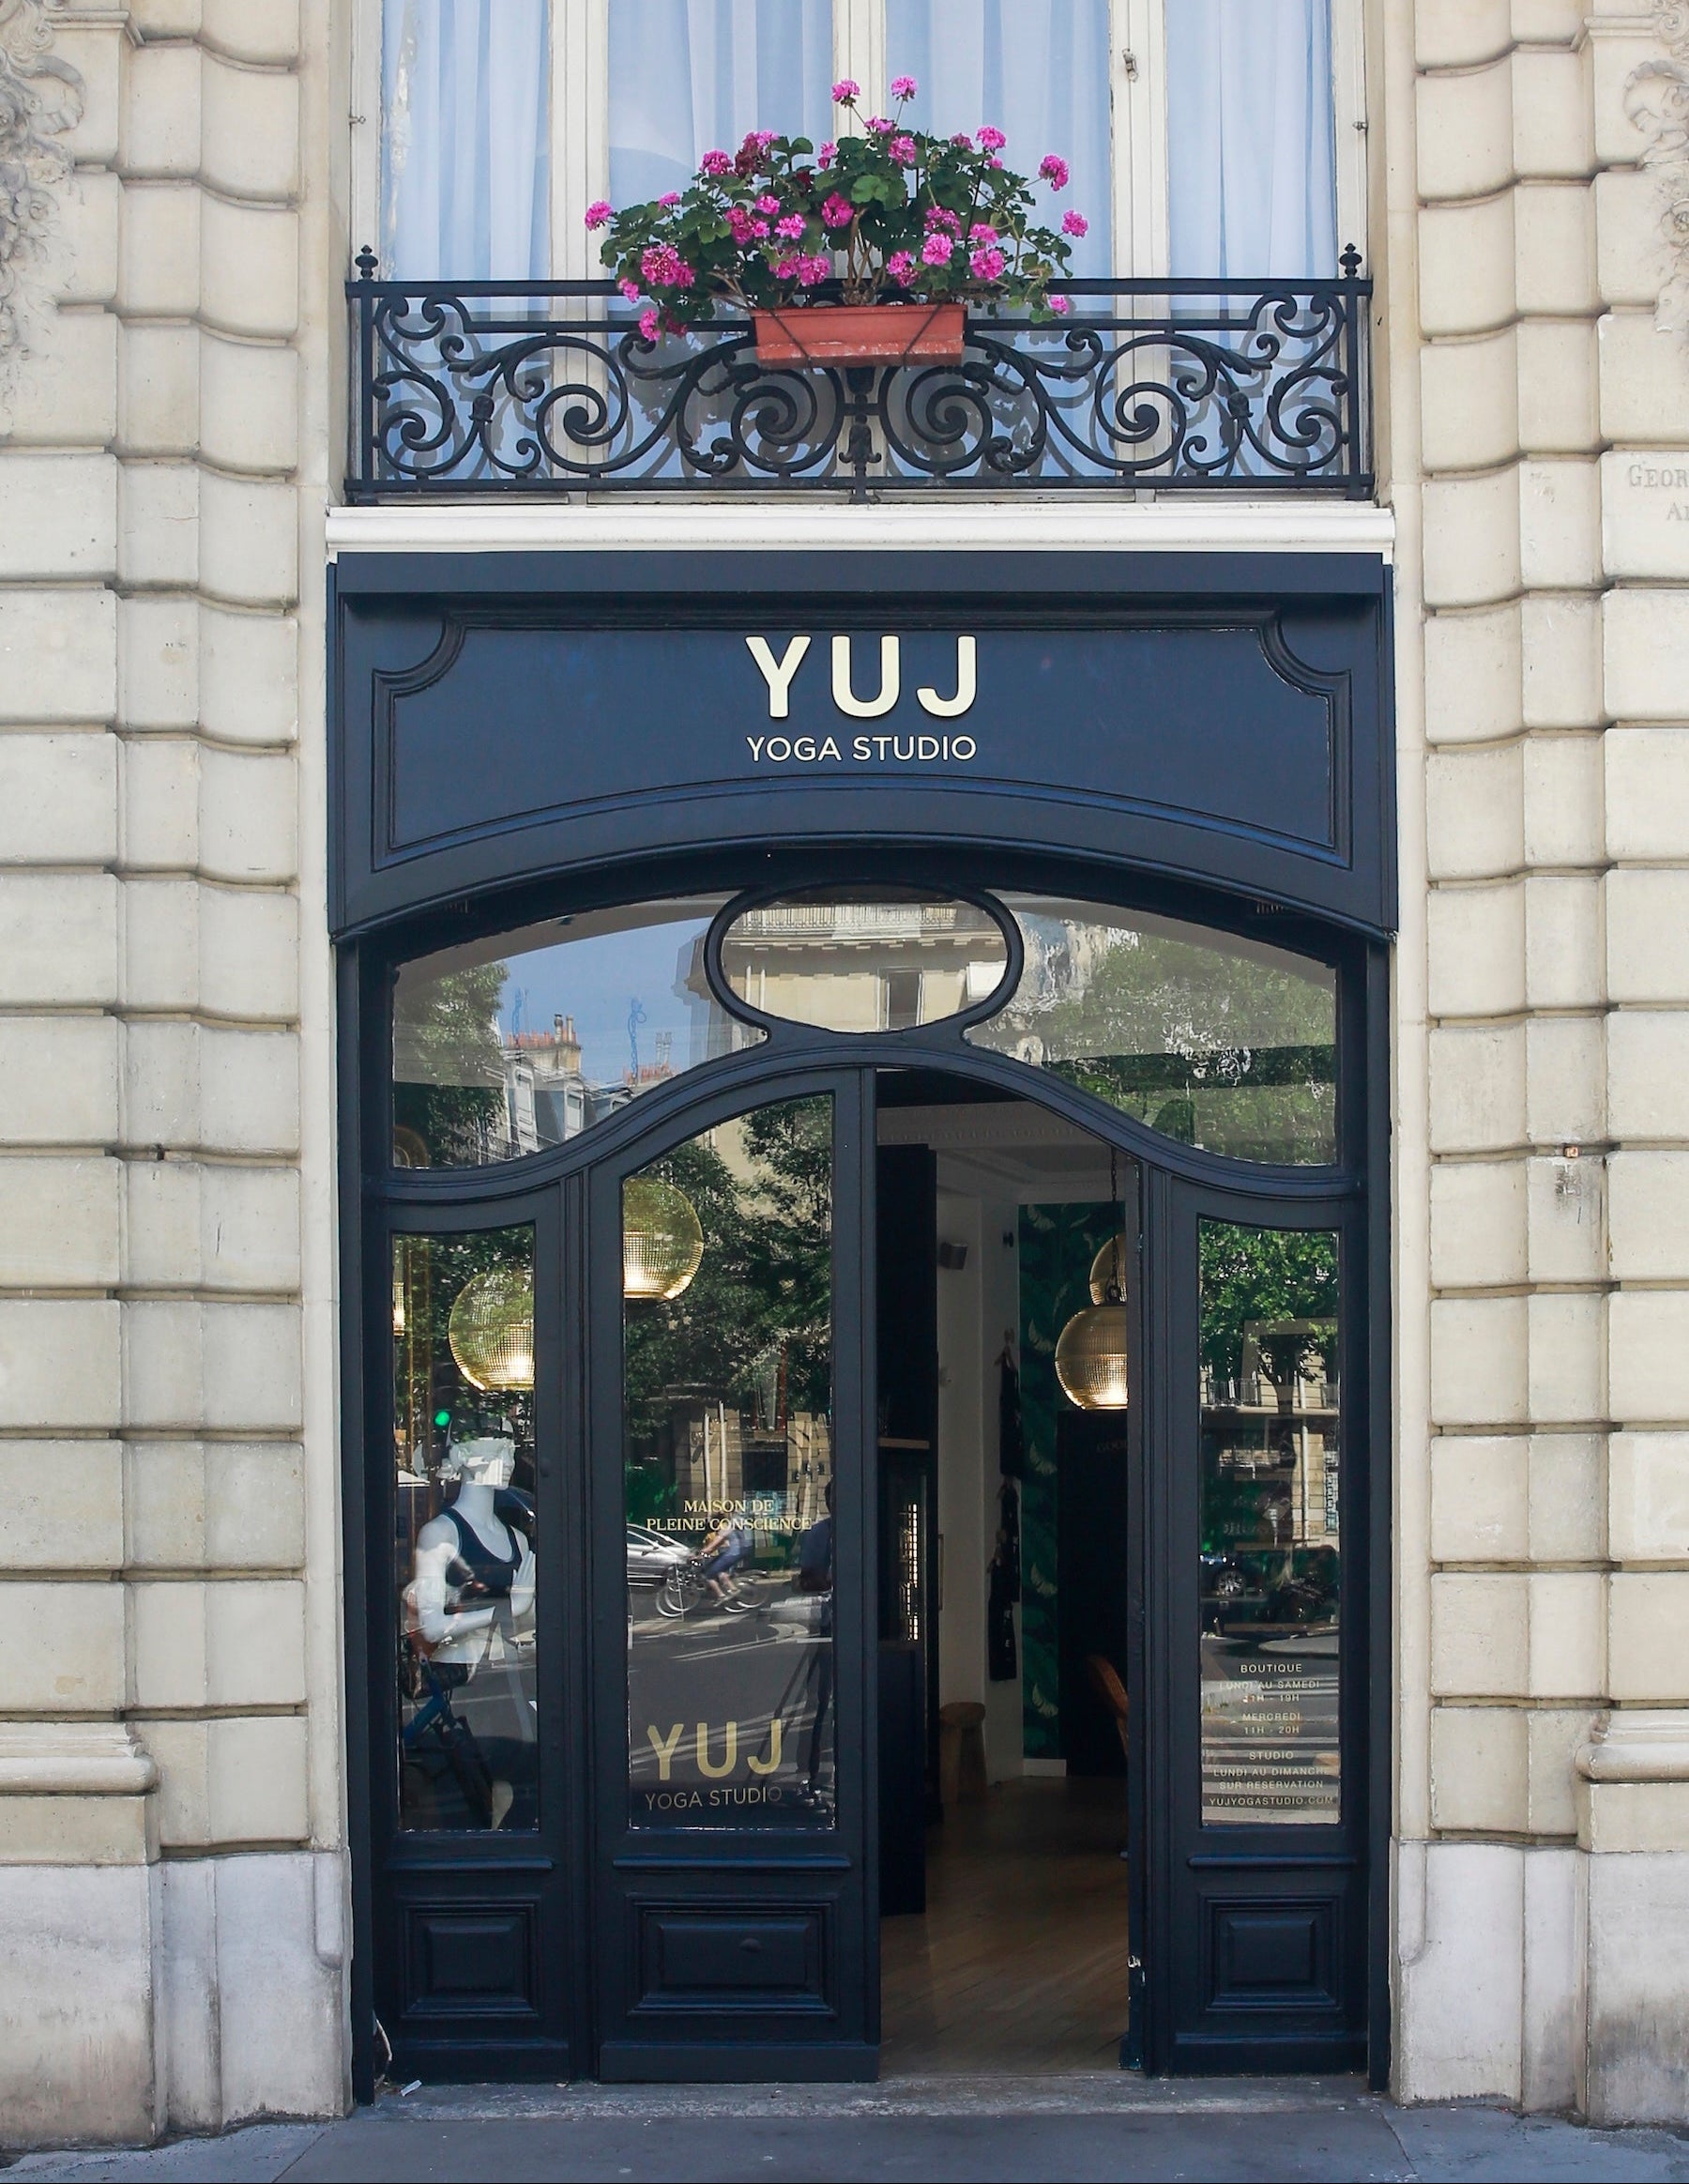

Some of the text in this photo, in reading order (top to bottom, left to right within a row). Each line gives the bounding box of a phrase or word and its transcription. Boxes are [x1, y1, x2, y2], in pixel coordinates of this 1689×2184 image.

[745, 634, 977, 718] YUJ
[747, 735, 978, 762] YOGA STUDIO
[683, 1499, 774, 1513] MAISON DE
[647, 1517, 813, 1531] PLEINE CONSCIENCE
[1240, 1663, 1303, 1673] BOUTIQUE
[1220, 1680, 1320, 1690] LUNDI AU SAMEDI
[1279, 1693, 1301, 1703] 19H
[1242, 1712, 1301, 1721] MERCREDI
[1244, 1726, 1265, 1734] 11H
[1278, 1725, 1301, 1734] 20H
[647, 1718, 782, 1780] YUJ
[1249, 1750, 1294, 1760] STUDIO
[1213, 1768, 1248, 1777] LUNDI
[1252, 1767, 1267, 1776] AU
[1220, 1779, 1324, 1790] SUR RESERVATION
[645, 1786, 783, 1810] YOGA STUDIO
